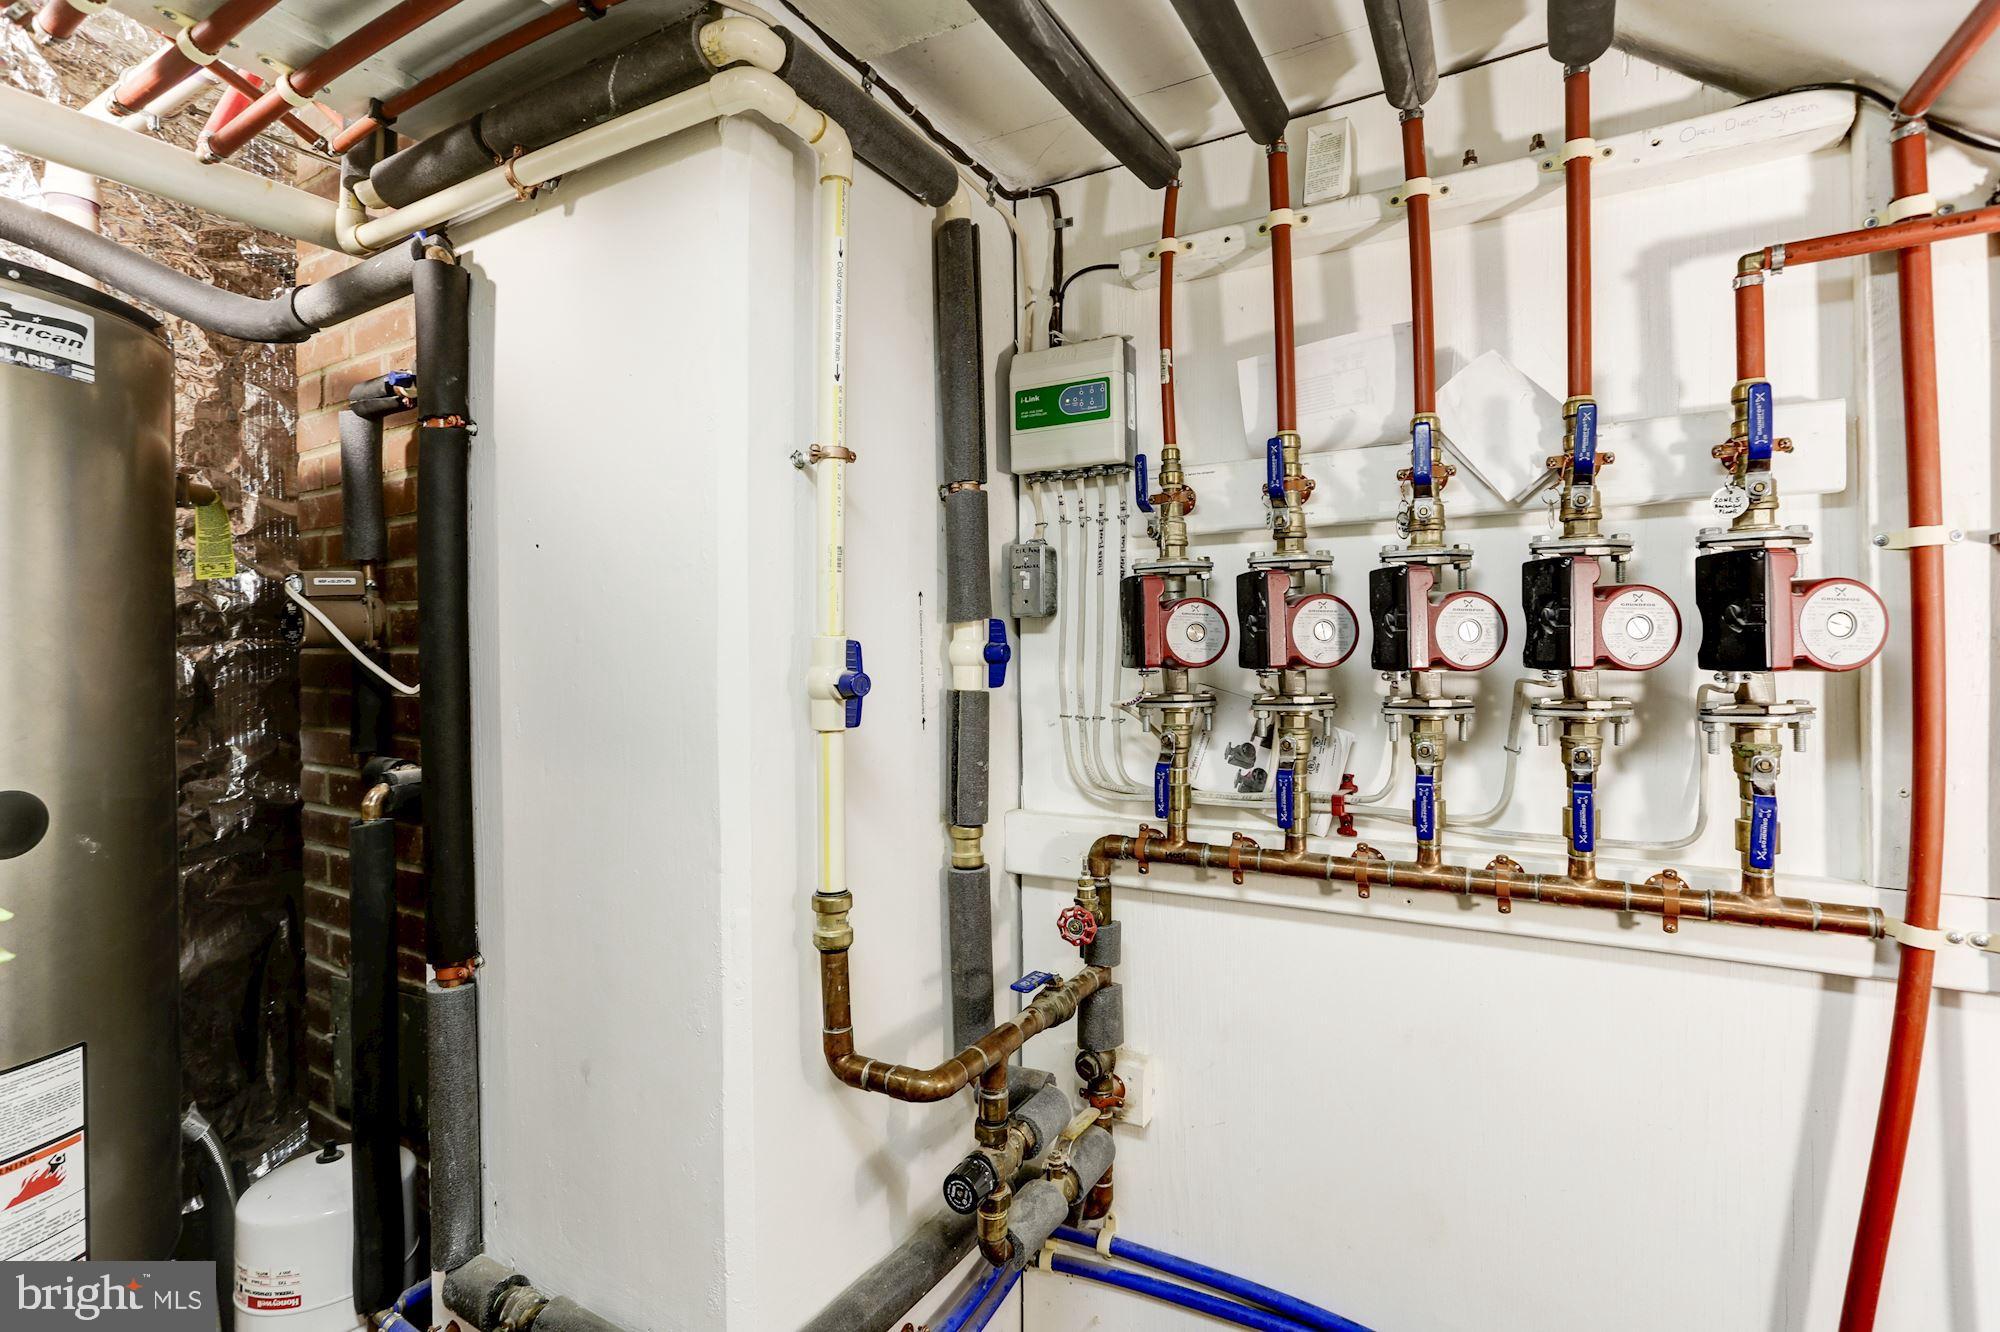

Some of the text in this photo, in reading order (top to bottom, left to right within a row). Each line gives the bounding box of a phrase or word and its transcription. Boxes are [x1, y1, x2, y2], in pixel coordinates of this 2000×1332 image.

[1932, 215, 1977, 230] PEX
[833, 261, 844, 362] Cold coming in from the main
[1020, 395, 1040, 404] i-Link
[256, 1297, 300, 1308] Honeywell
